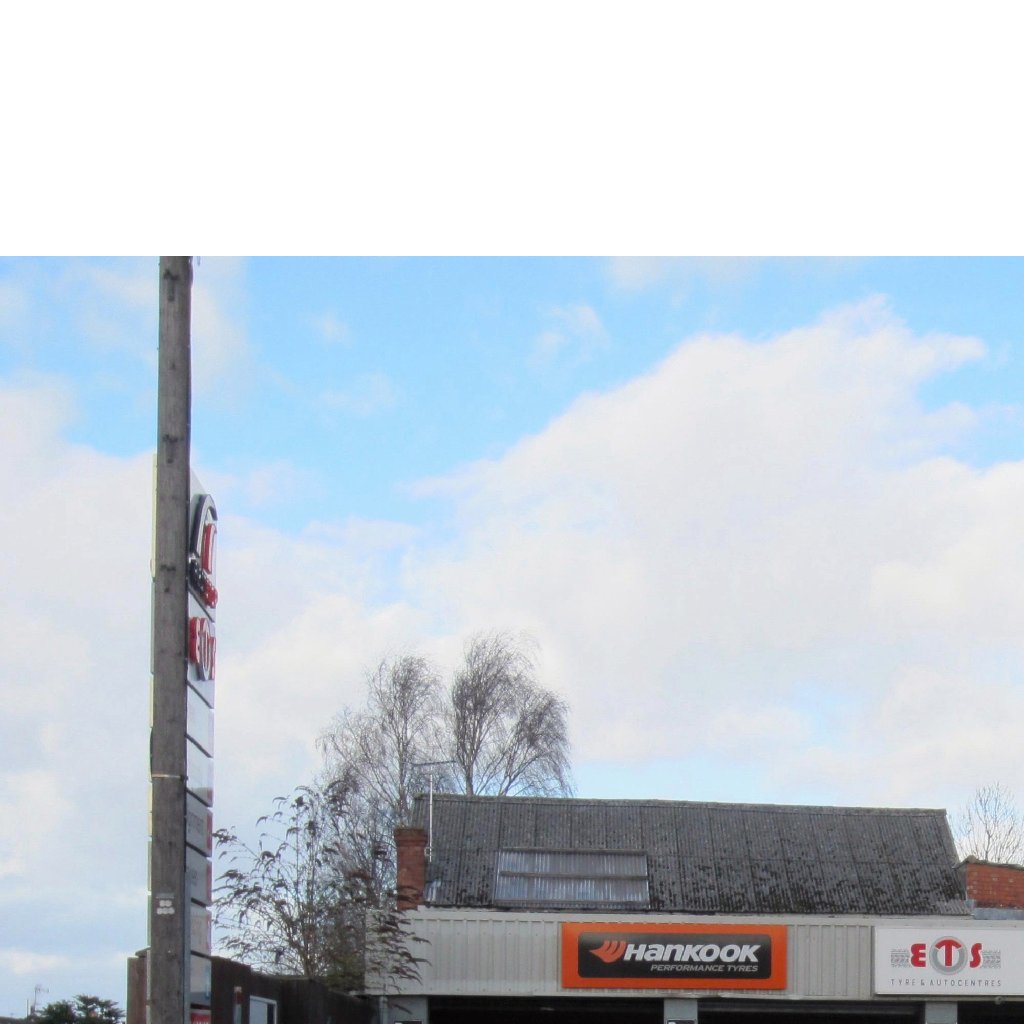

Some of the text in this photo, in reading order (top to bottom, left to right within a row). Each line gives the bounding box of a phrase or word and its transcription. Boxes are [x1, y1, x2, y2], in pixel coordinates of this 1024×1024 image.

[911, 939, 982, 968] ETS
[650, 964, 725, 972] PERFORMANCE
[929, 979, 1001, 987] AUTOCENTRES
